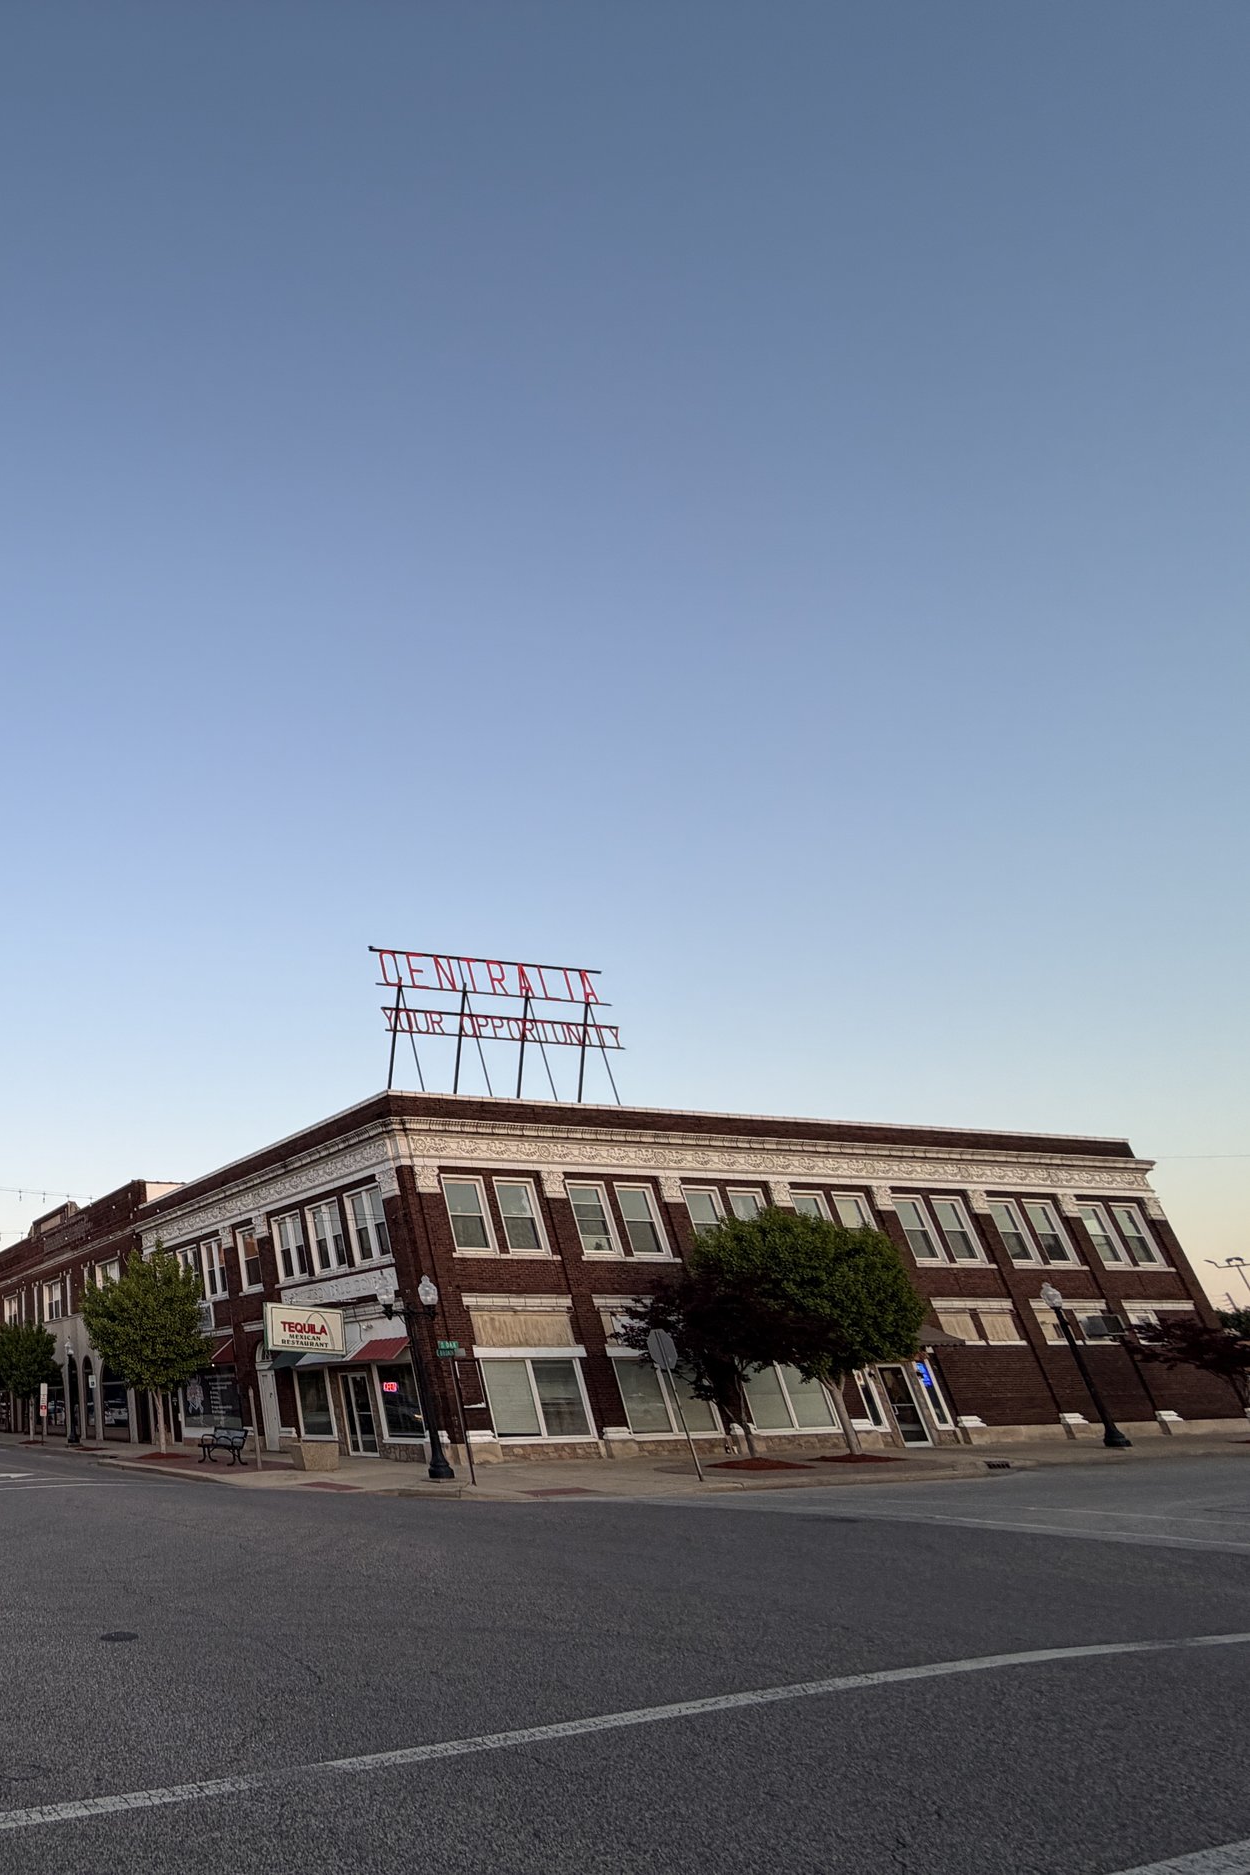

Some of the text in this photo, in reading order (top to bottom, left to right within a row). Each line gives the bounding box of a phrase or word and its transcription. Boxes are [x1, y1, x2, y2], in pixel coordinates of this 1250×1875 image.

[379, 950, 600, 1004] CENTRALIA
[381, 1007, 621, 1048] YOUR OPPORTUNITY
[280, 1321, 327, 1336] TEQUILA
[281, 1339, 329, 1348] RESTAURANT
